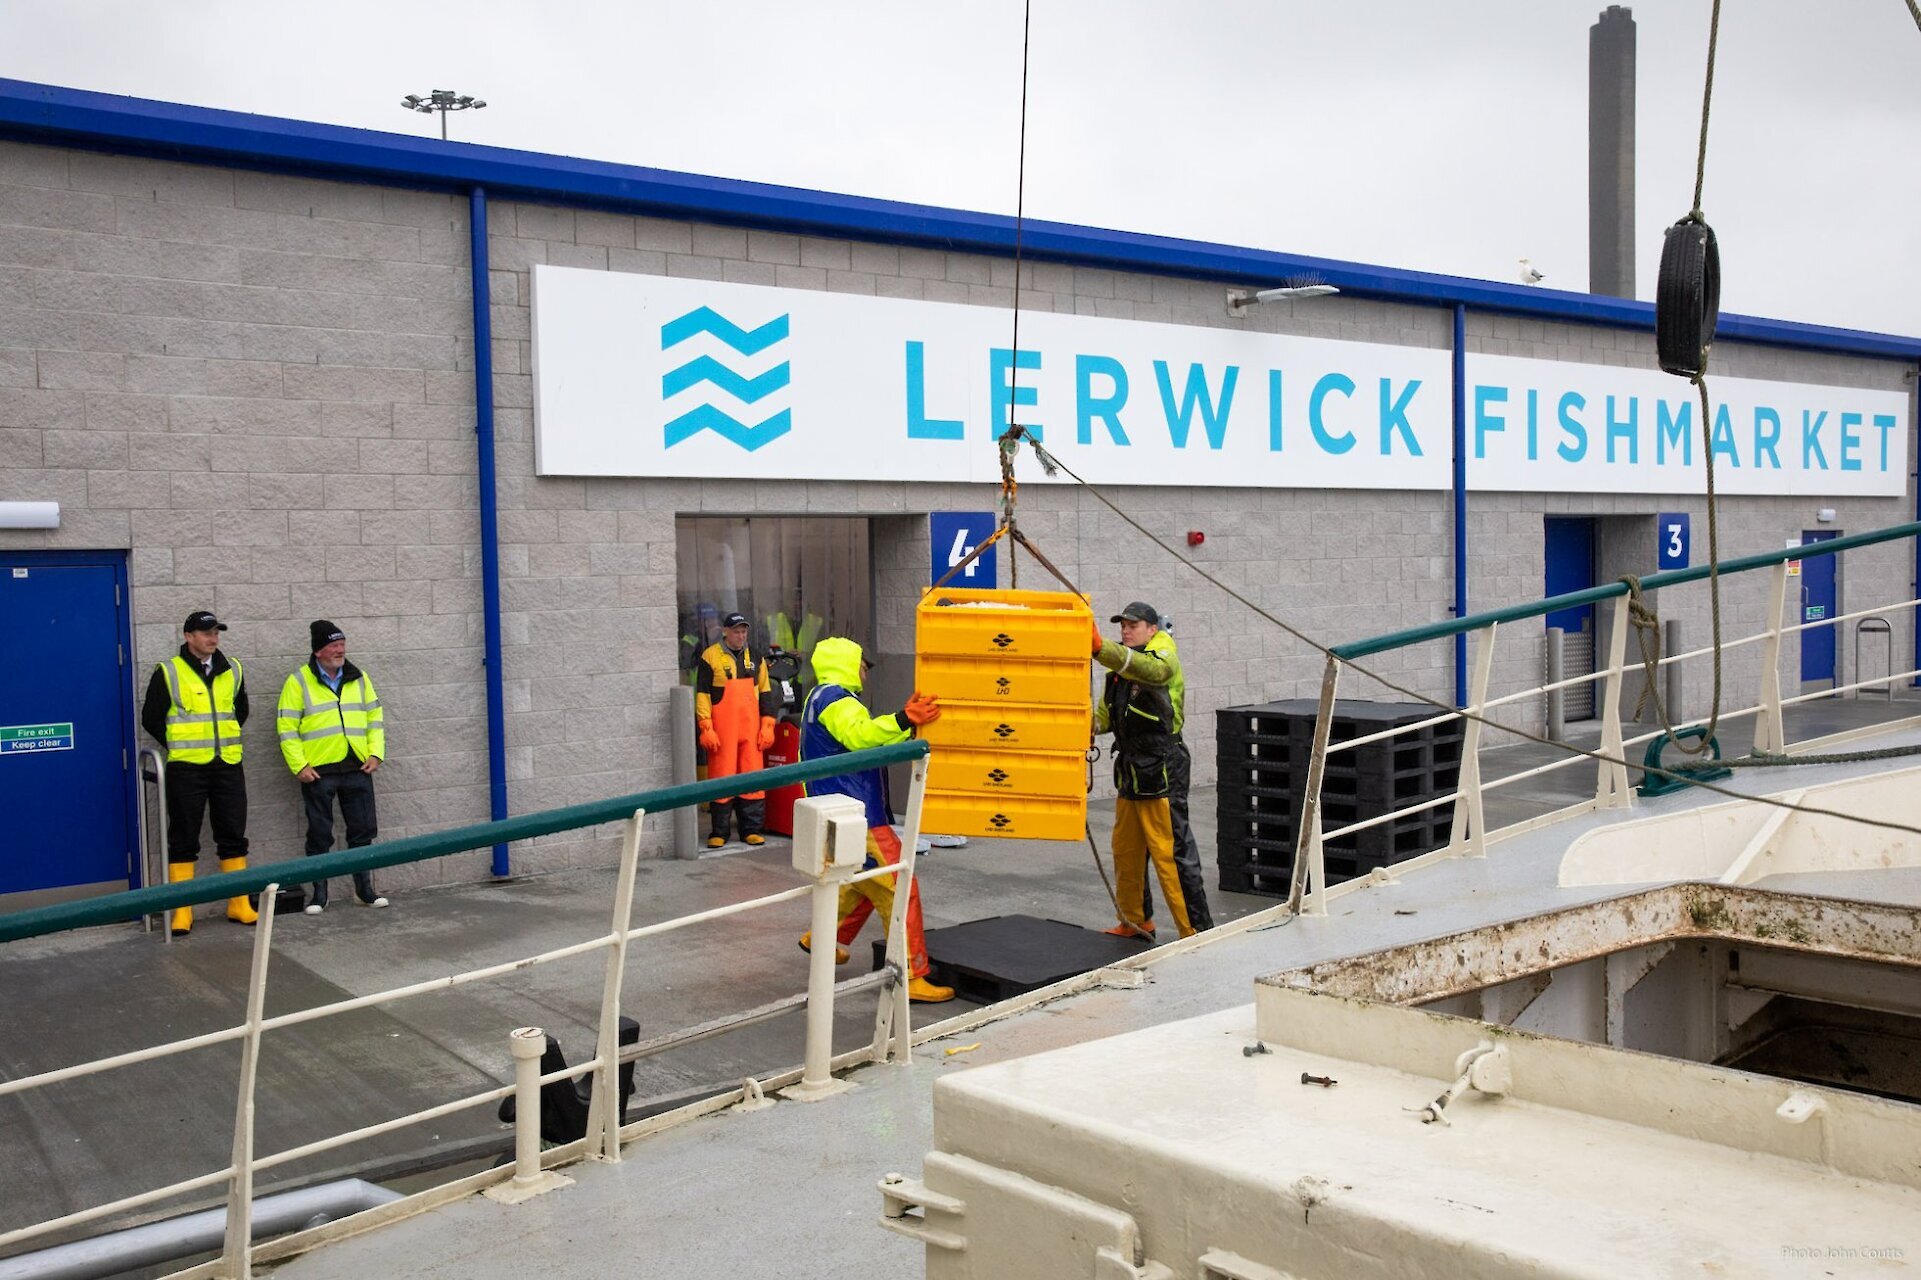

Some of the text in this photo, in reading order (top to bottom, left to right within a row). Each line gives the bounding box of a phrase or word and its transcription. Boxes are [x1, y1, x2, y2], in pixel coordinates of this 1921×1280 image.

[906, 340, 1897, 472] LERWICK FISHMARKET
[948, 528, 980, 577] 4
[1667, 524, 1683, 558] 3
[12, 739, 62, 750] Keep clear
[17, 727, 55, 737] Fire exit
